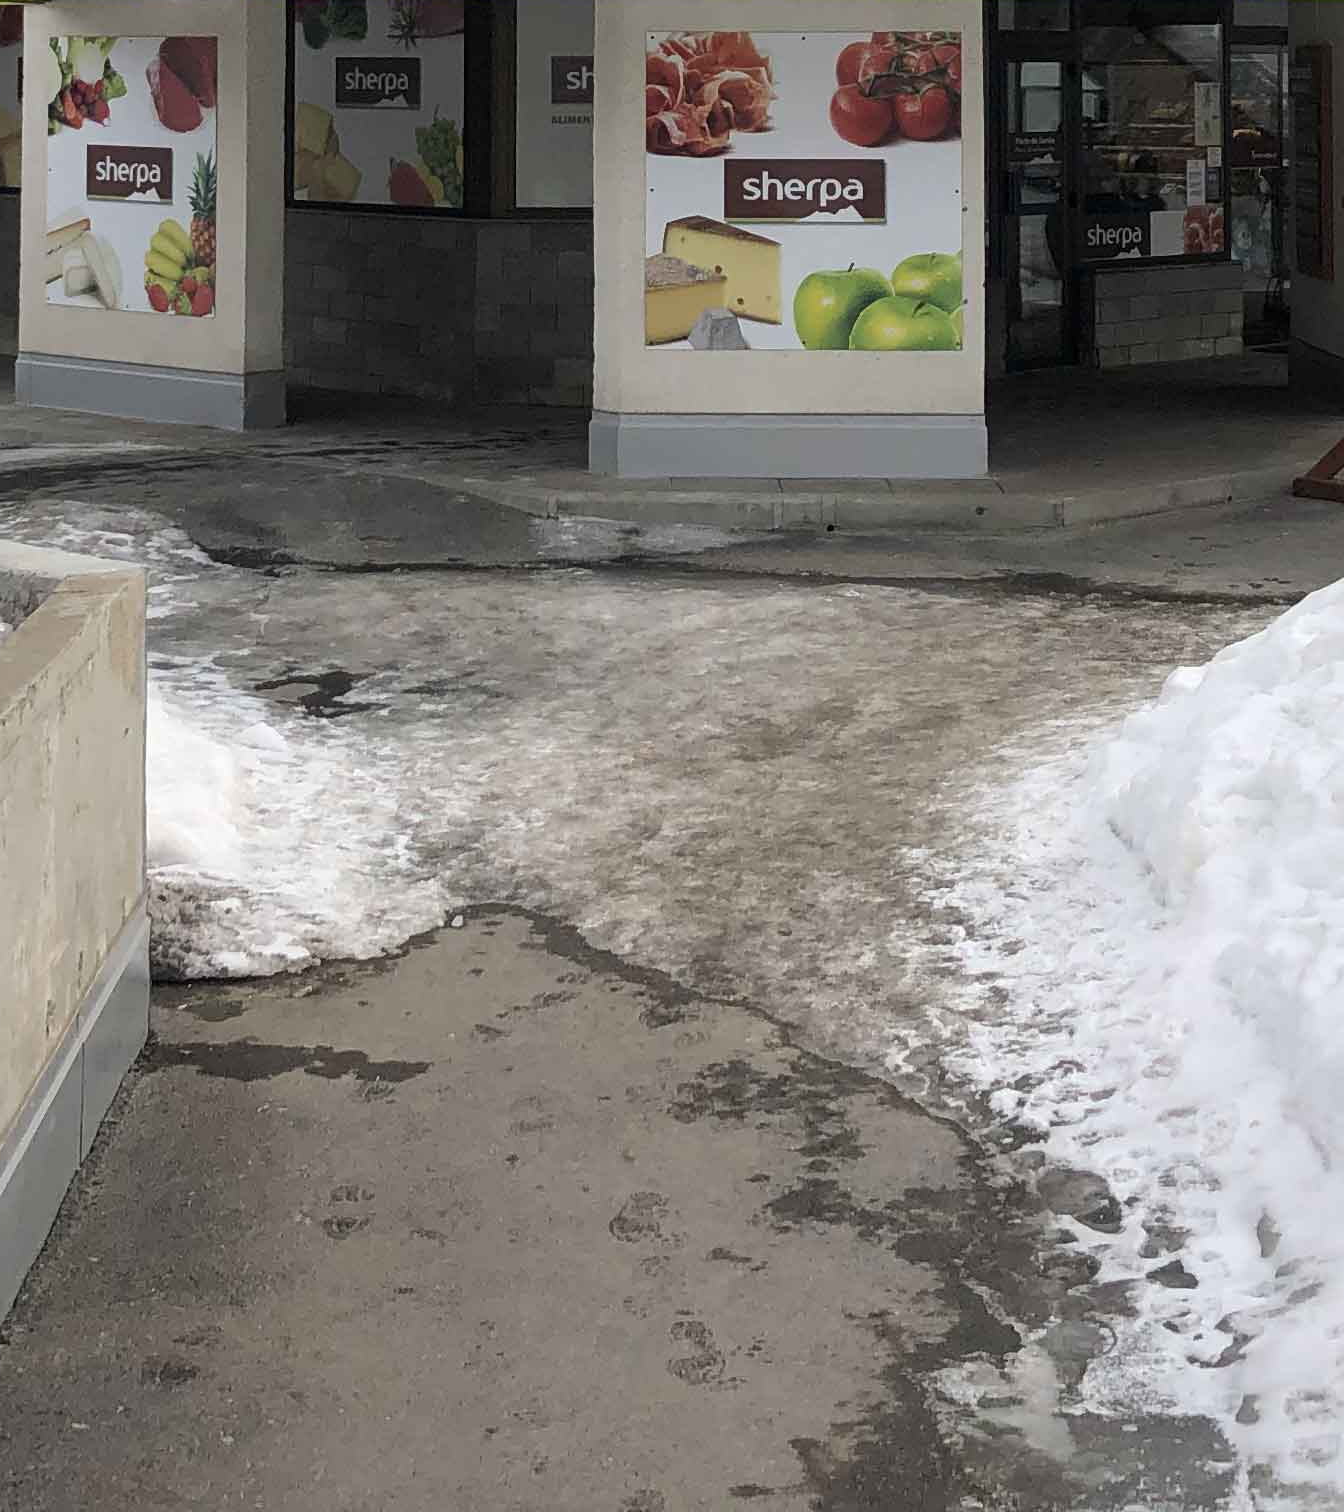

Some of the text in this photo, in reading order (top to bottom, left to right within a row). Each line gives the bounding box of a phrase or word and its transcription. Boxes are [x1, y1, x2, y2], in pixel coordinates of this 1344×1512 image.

[344, 66, 409, 95] sherpa
[95, 155, 161, 189] sherpa
[742, 170, 864, 207] sherpa
[1087, 223, 1142, 253] sherpa
